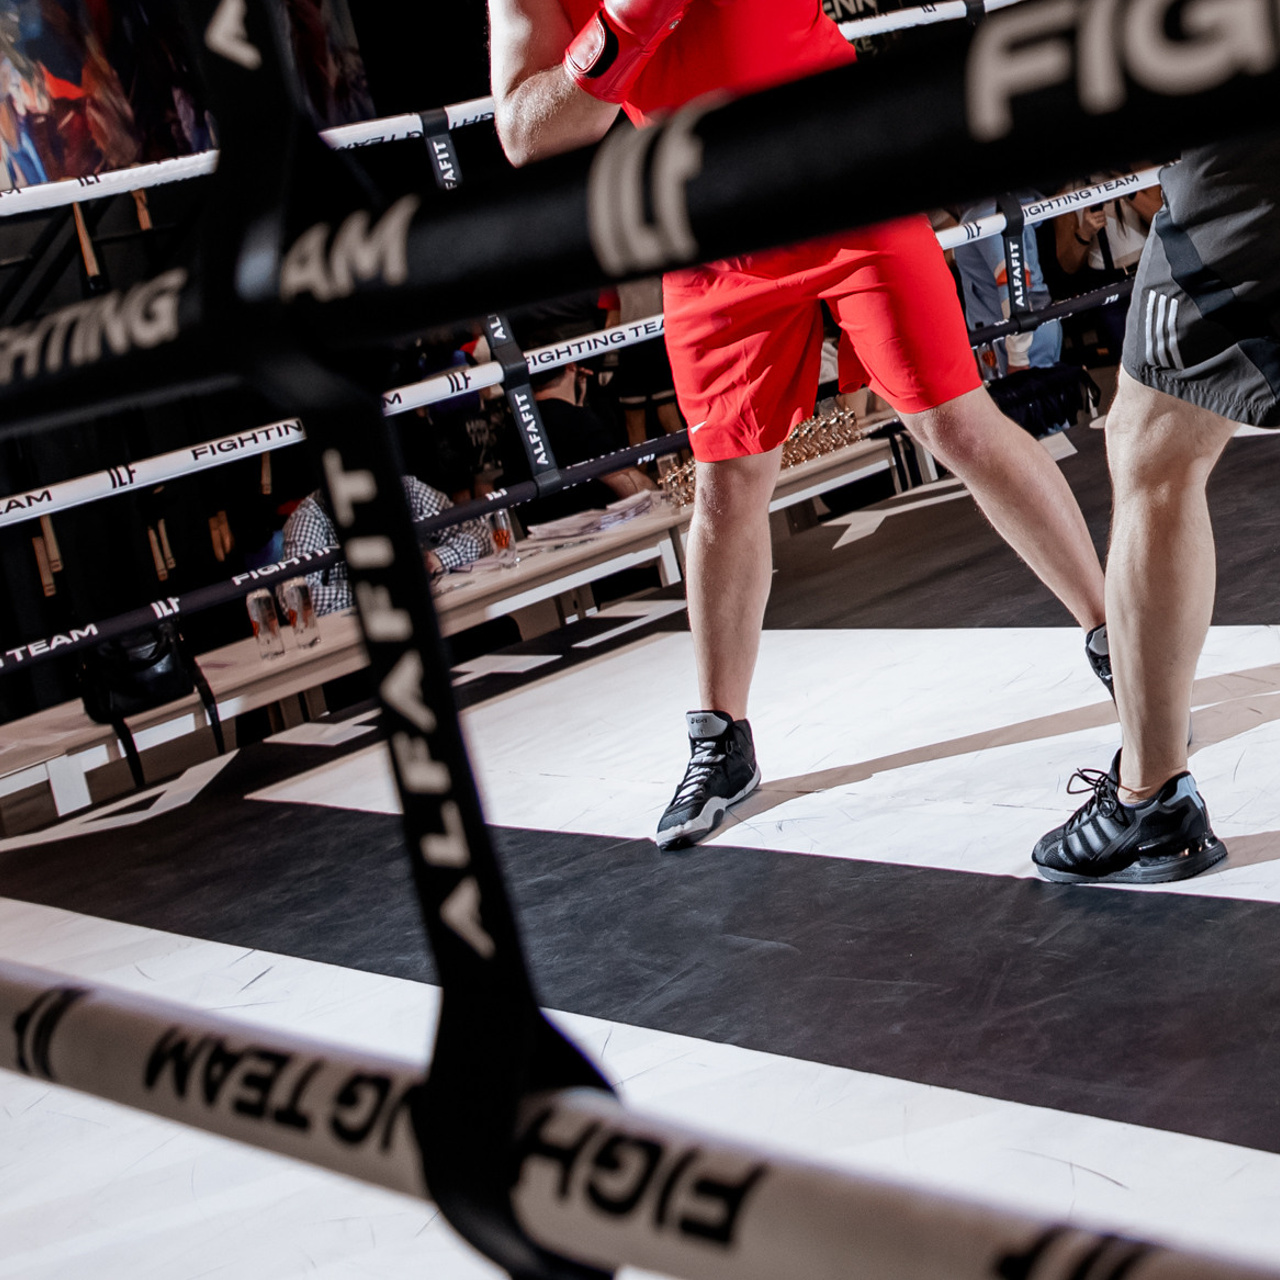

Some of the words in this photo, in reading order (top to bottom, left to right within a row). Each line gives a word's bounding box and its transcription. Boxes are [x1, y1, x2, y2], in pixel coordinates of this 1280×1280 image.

[1024, 189, 1091, 218] IGHTING
[1092, 174, 1139, 195] TEAM
[279, 192, 421, 303] AM
[1009, 241, 1025, 307] ALFAFIT
[191, 420, 304, 461] FIGHTIN
[514, 392, 549, 466] ALFAFIT
[0, 489, 53, 514] AM
[6, 624, 99, 663] TEAM
[322, 447, 496, 960] ALFAFIT
[143, 1025, 323, 1133] TEAM
